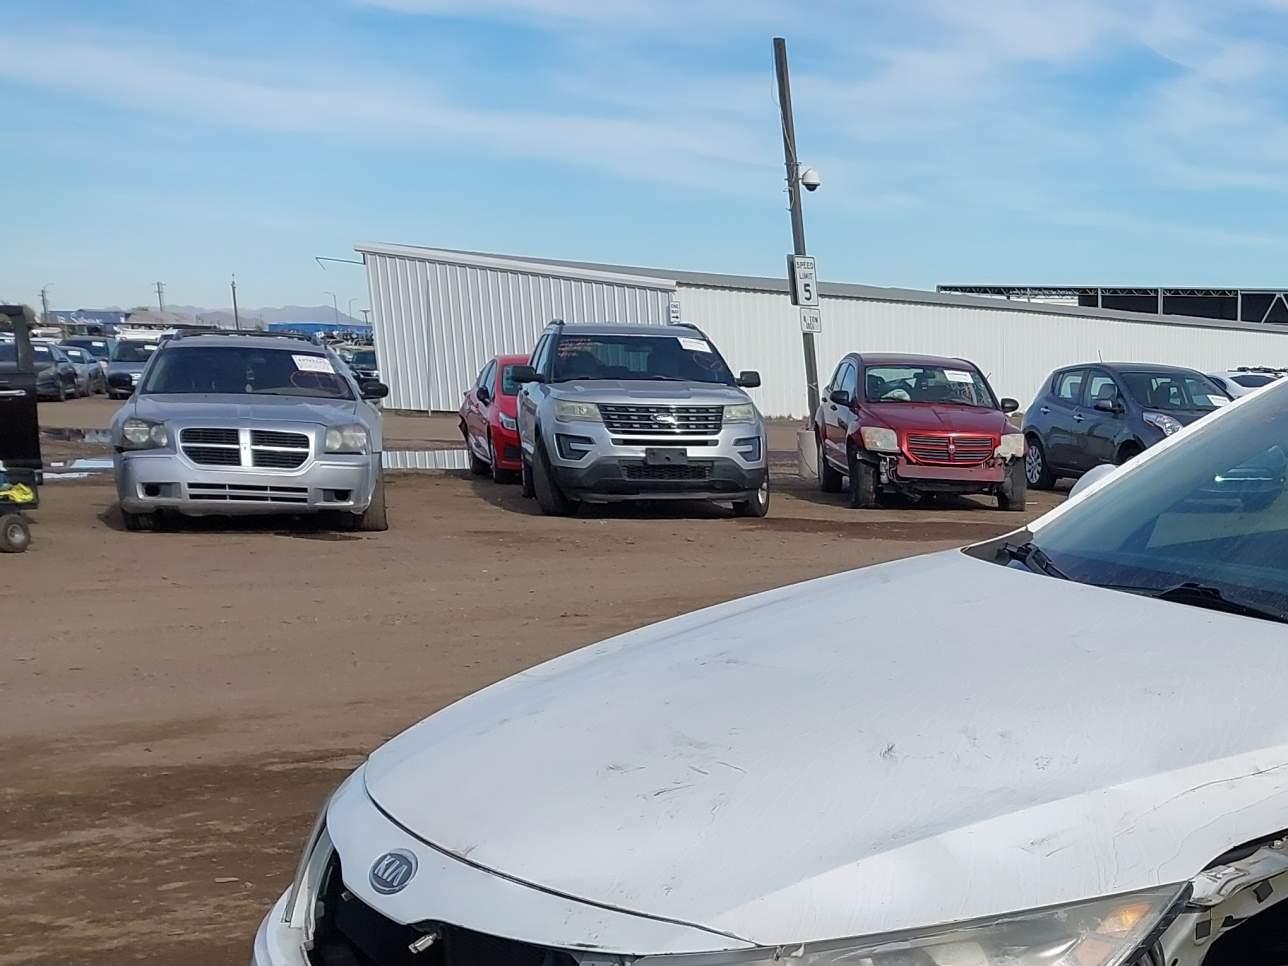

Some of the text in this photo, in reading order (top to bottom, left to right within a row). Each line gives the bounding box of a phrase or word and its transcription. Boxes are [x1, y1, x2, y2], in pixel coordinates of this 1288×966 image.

[797, 262, 814, 270] SPEED
[799, 272, 813, 280] LIMIT
[804, 283, 812, 300] 5
[374, 856, 408, 886] KIA
